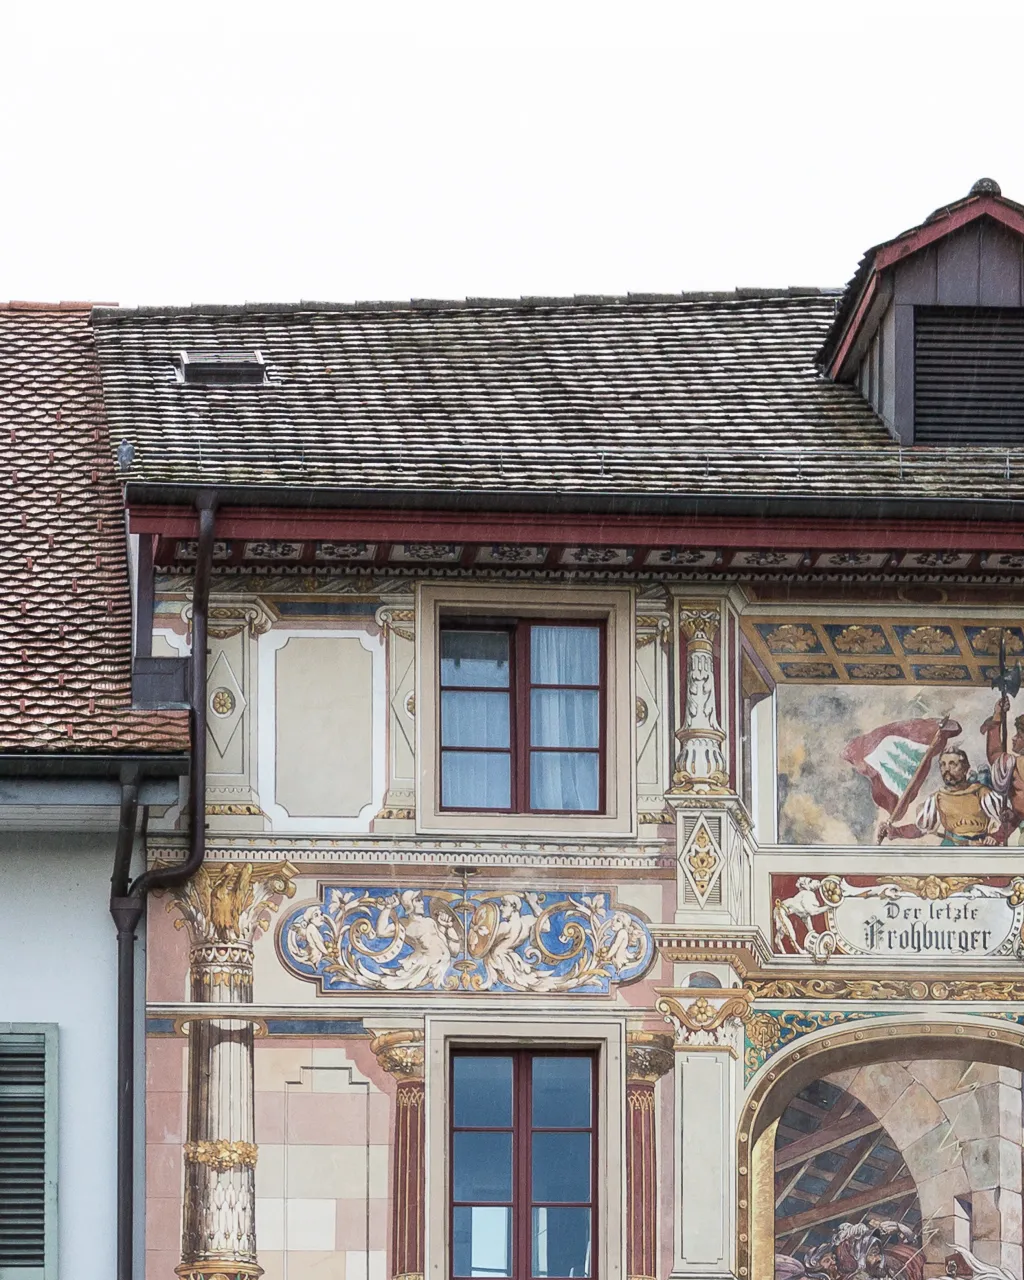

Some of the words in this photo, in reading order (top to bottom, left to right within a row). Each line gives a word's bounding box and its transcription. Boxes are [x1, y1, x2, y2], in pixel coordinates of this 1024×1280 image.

[883, 901, 921, 919] Der
[930, 901, 978, 922] letzte
[863, 915, 992, 955] Frohburger
